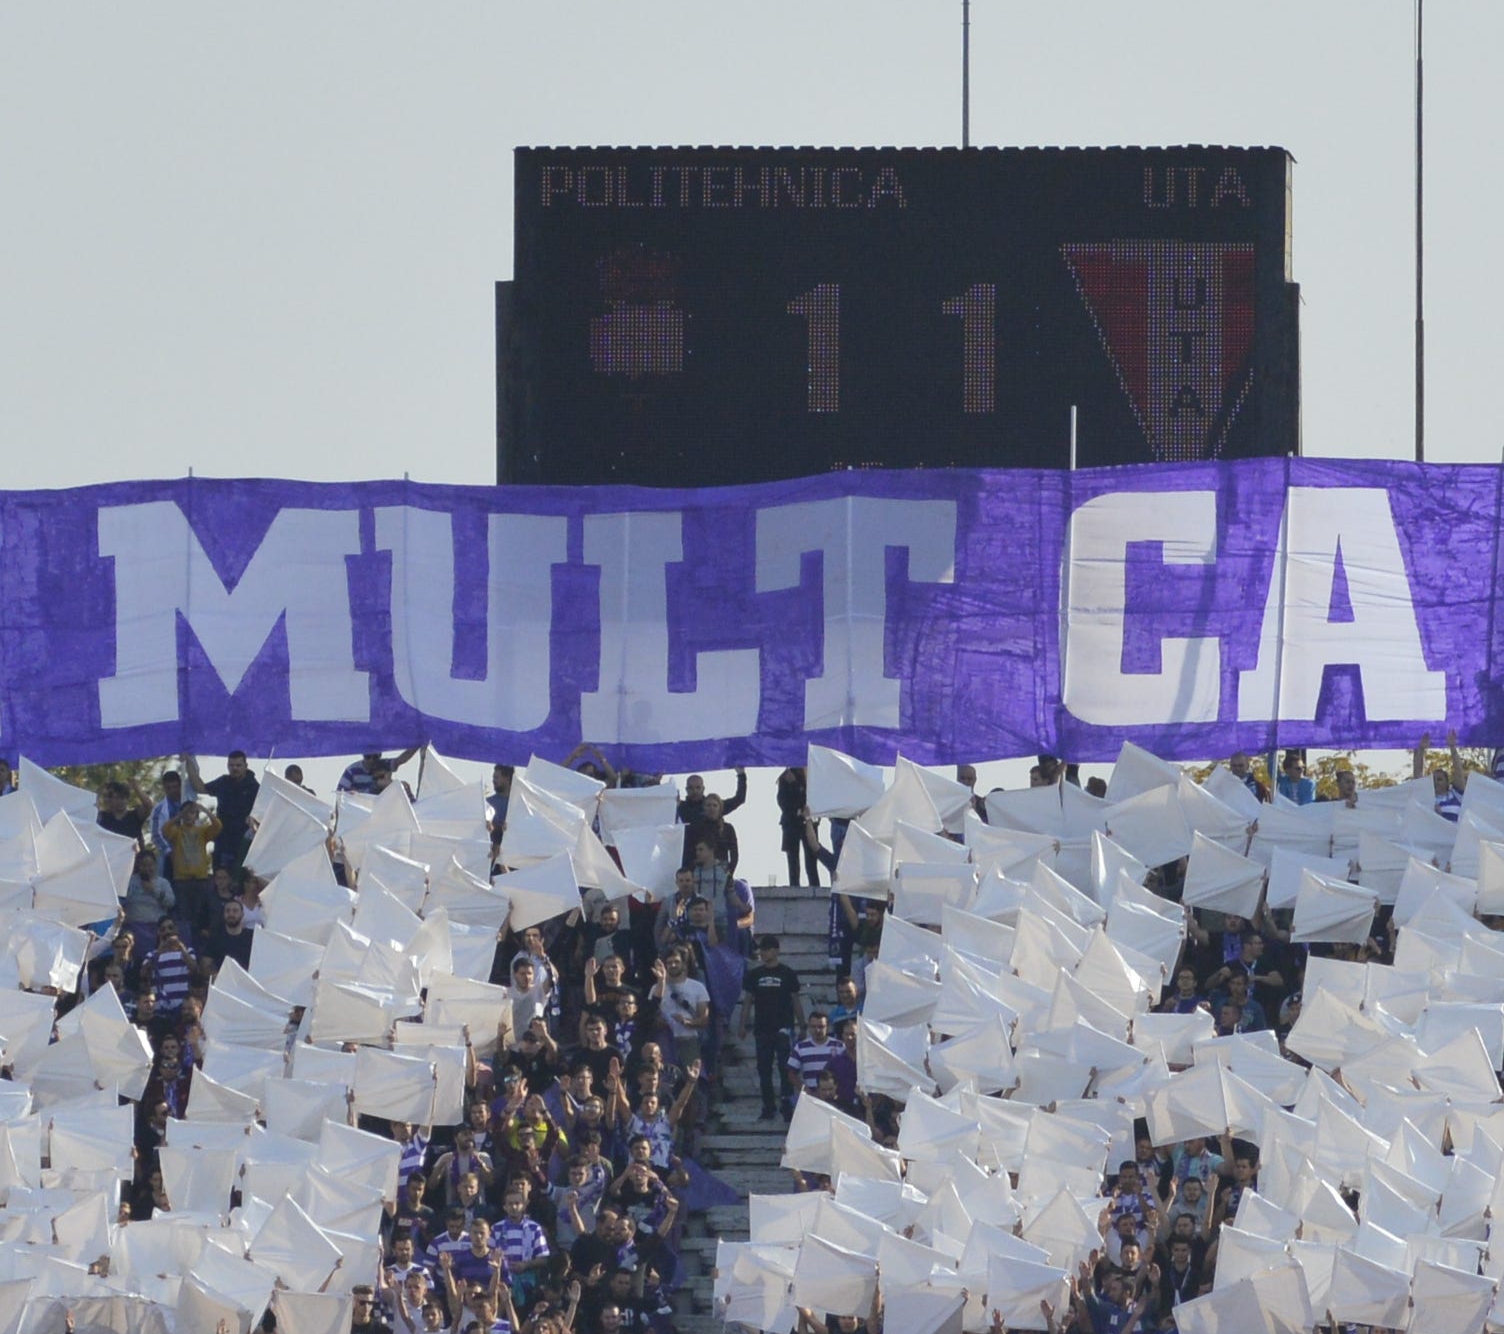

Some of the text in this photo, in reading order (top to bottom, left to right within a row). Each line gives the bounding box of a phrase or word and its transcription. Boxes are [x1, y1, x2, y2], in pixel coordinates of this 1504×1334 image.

[541, 166, 1251, 208] POLITEHNICA UTA
[786, 283, 996, 413] 1 1
[97, 493, 957, 745] MULT
[1064, 486, 1447, 728] CA
